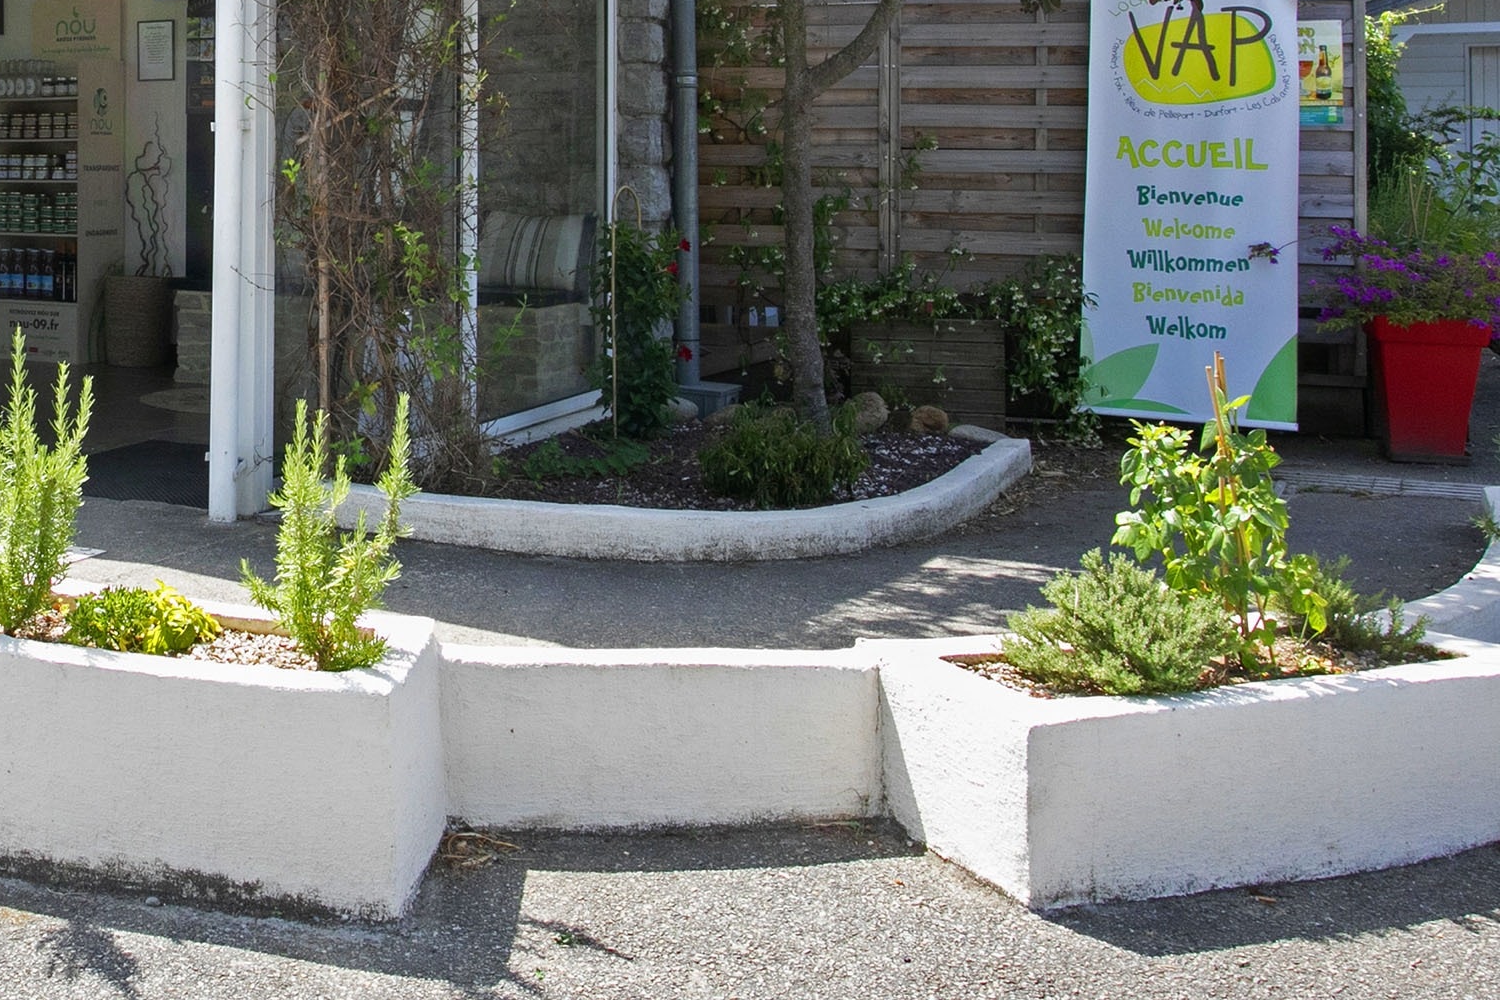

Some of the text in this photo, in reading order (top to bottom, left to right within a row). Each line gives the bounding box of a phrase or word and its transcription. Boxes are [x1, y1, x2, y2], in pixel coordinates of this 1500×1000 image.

[1128, 6, 1273, 87] VAP
[1144, 108, 1156, 118] de
[1204, 105, 1237, 118] Durfort
[1246, 101, 1262, 111] Les
[1116, 135, 1268, 170] ACCUEIL
[1137, 185, 1244, 207] Bienvenue
[1142, 218, 1235, 240] Welcome
[1127, 249, 1251, 273] Willkommen
[1132, 281, 1244, 307] Bienvenida
[1146, 315, 1227, 340] Welkom
